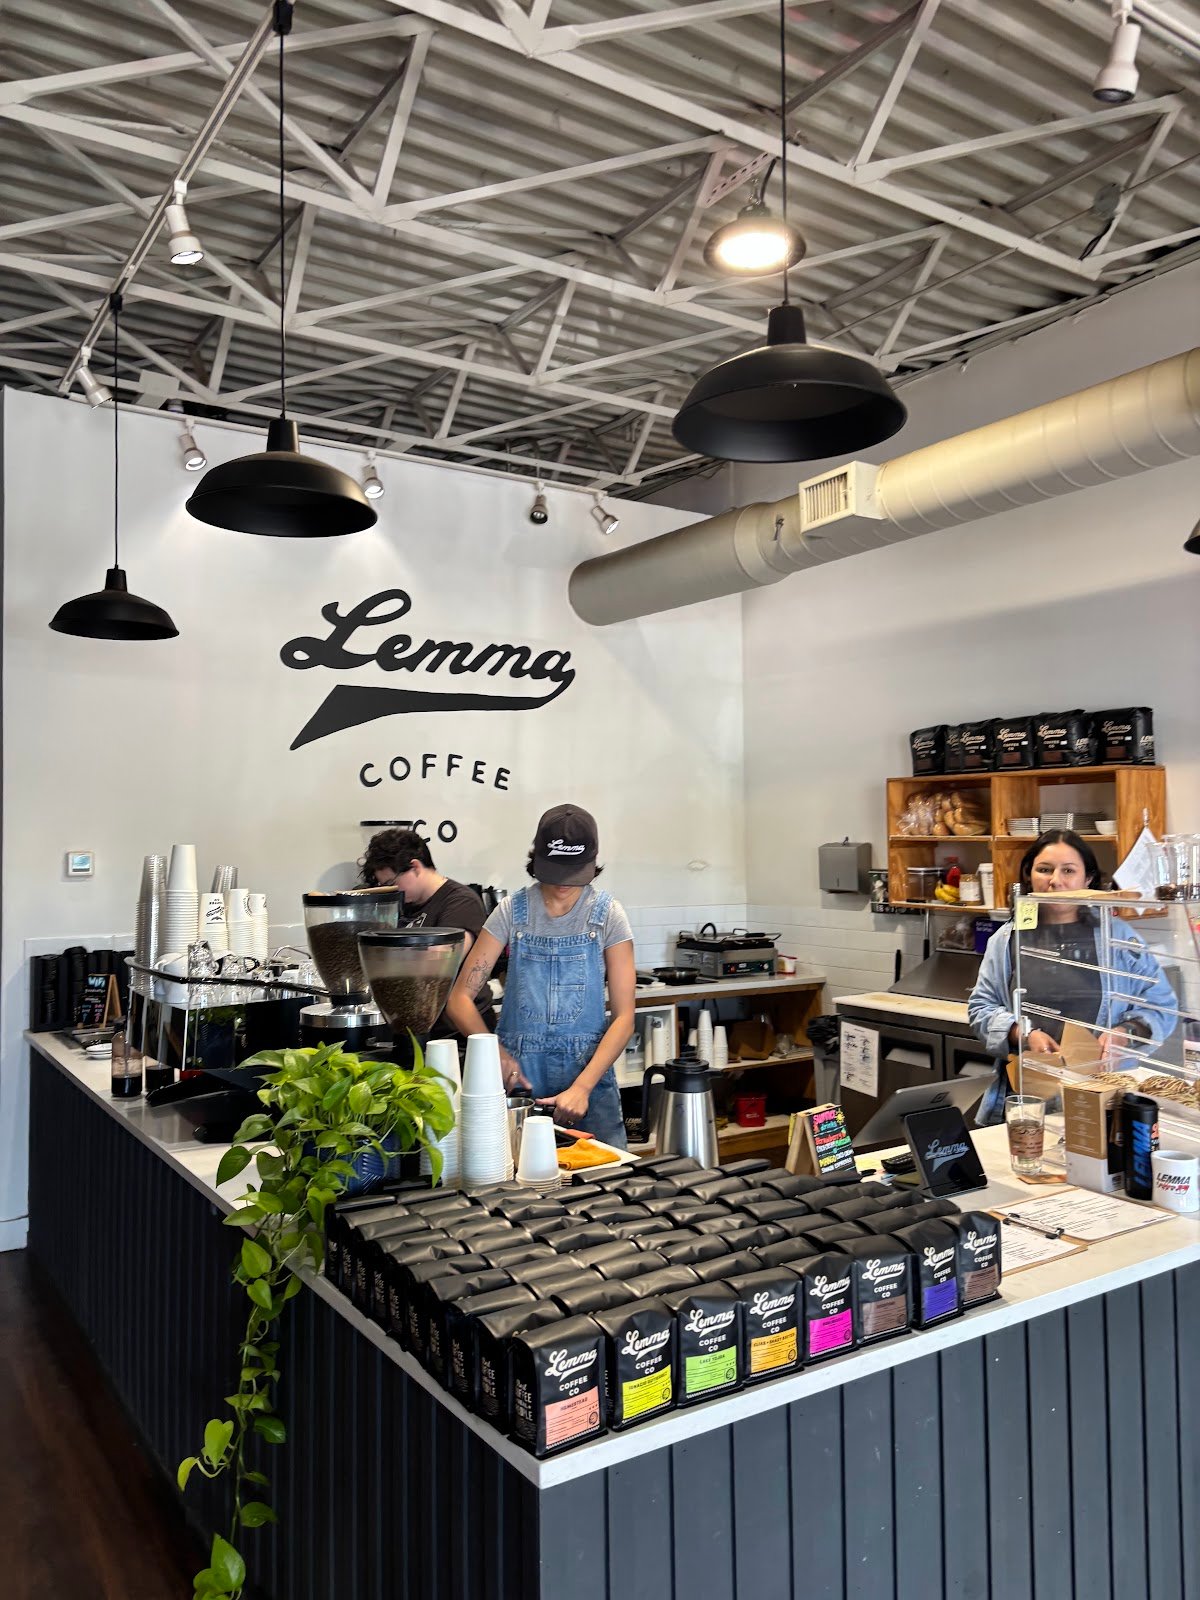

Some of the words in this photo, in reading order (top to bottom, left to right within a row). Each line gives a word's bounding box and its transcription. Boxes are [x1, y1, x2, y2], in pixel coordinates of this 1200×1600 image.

[280, 589, 576, 751] Lemma
[996, 728, 1027, 742] Lemma
[1038, 723, 1067, 740] Lemma
[359, 753, 511, 791] COFFEE
[547, 839, 586, 856] Lemma
[924, 1138, 970, 1172] Lemma
[1156, 1172, 1191, 1185] LEMMA
[861, 1258, 906, 1286] Lemma
[808, 1275, 851, 1303] Lemma
[873, 1282, 898, 1294] COFFEE
[881, 1291, 892, 1299] CO
[749, 1291, 796, 1321] Lemma
[821, 1297, 845, 1310] COFFEE
[828, 1307, 839, 1315] CO
[684, 1306, 736, 1339] Lemma
[761, 1316, 787, 1329] COFFEE
[770, 1325, 781, 1334] CO
[620, 1328, 671, 1362] Lemma
[698, 1333, 727, 1347] COFFEE
[707, 1344, 719, 1353] CO
[544, 1348, 598, 1383] Lemma
[634, 1354, 663, 1370] COFFEE
[644, 1366, 656, 1375] CO
[558, 1375, 589, 1392] COFFEE
[568, 1387, 580, 1397] CO
